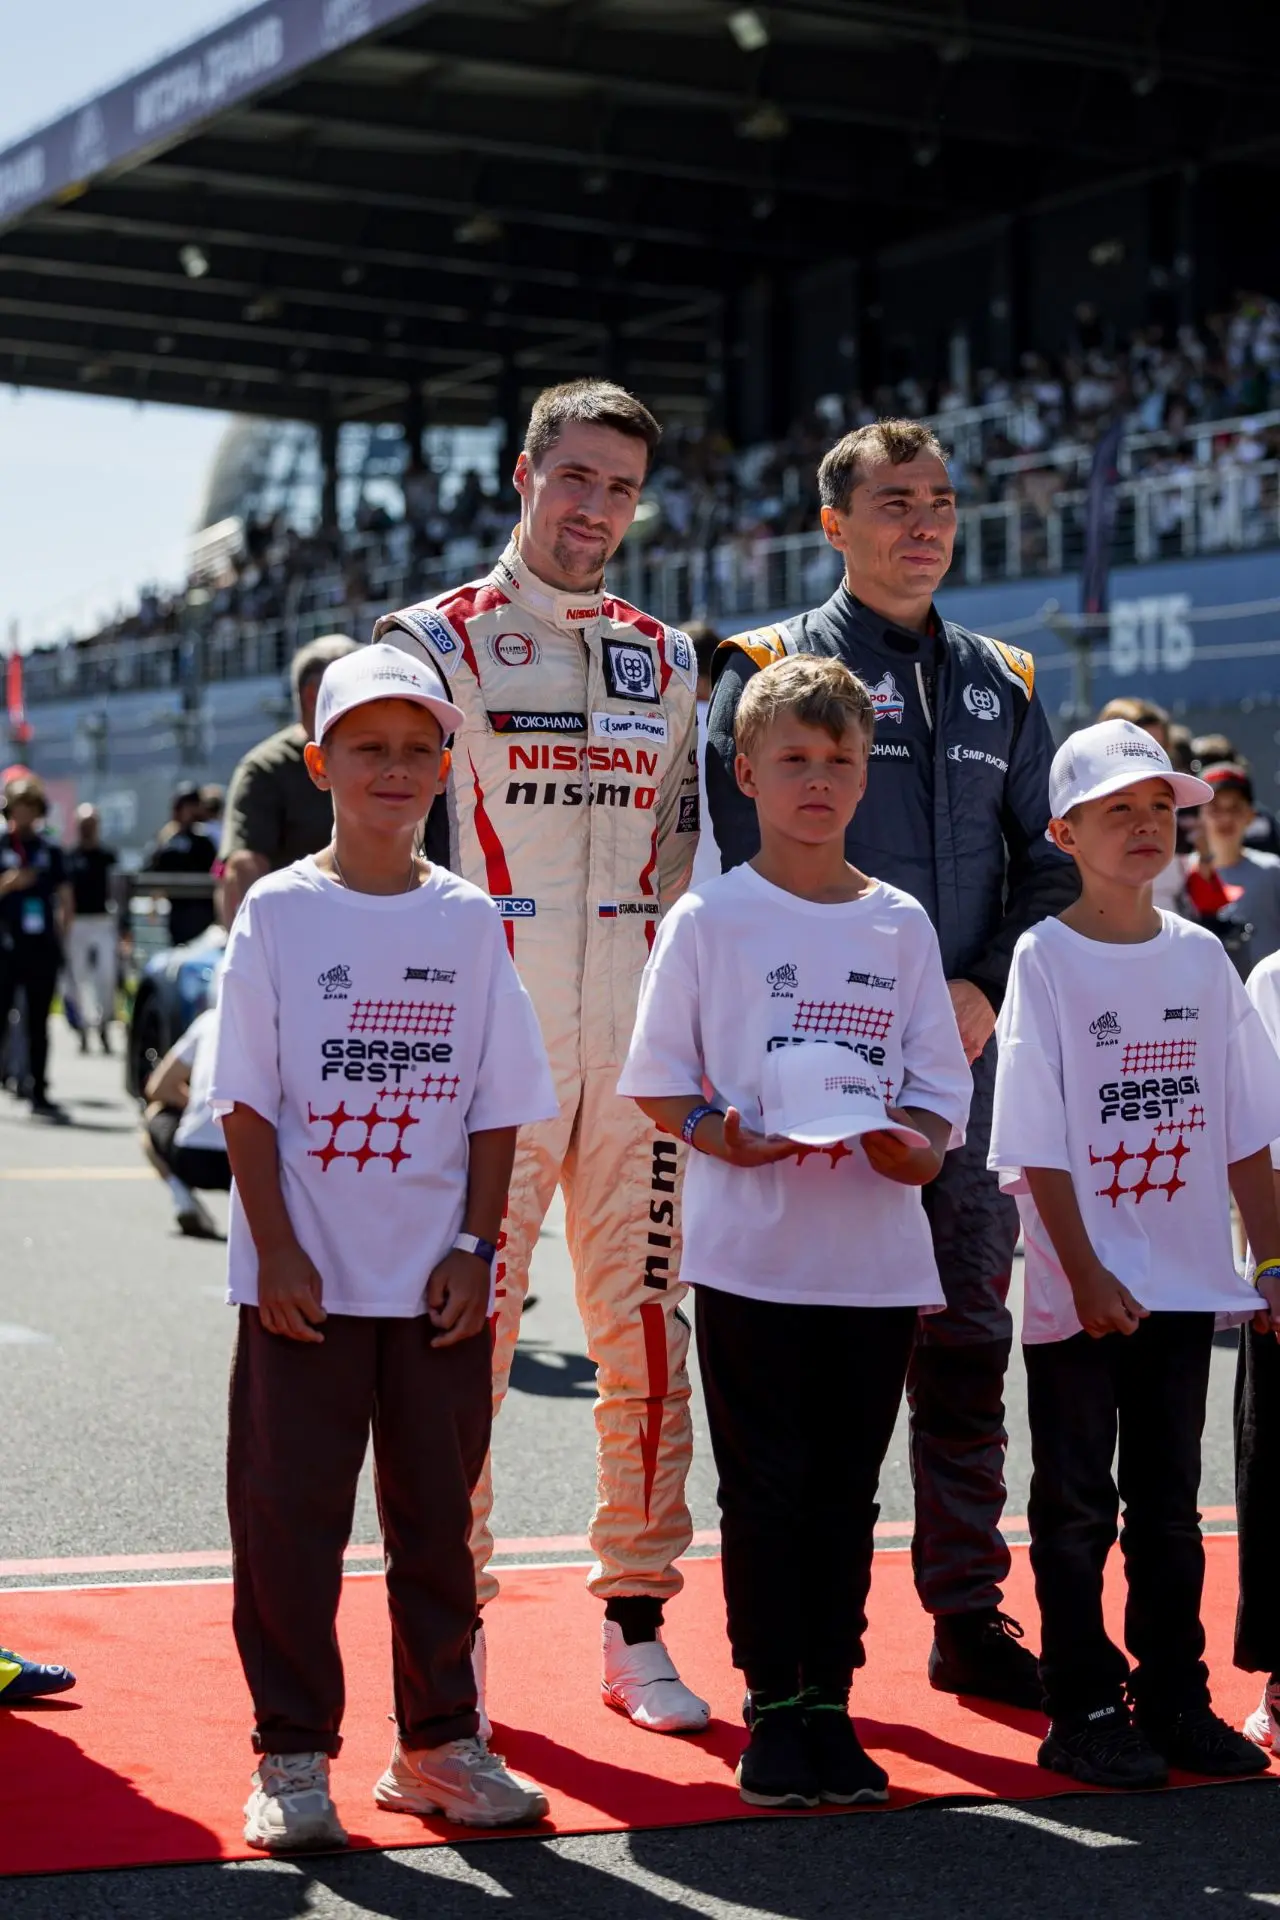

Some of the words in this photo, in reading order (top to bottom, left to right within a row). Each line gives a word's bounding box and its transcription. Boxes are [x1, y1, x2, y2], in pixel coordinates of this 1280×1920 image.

[512, 714, 583, 730] YOKOHAMA
[611, 722, 632, 732] SMP
[635, 722, 664, 737] RACING
[869, 744, 910, 757] OHAMA
[962, 749, 985, 761] SMP
[508, 745, 658, 776] NISSAN
[505, 782, 657, 810] nismo
[495, 900, 533, 912] arco
[644, 1121, 678, 1291] nism
